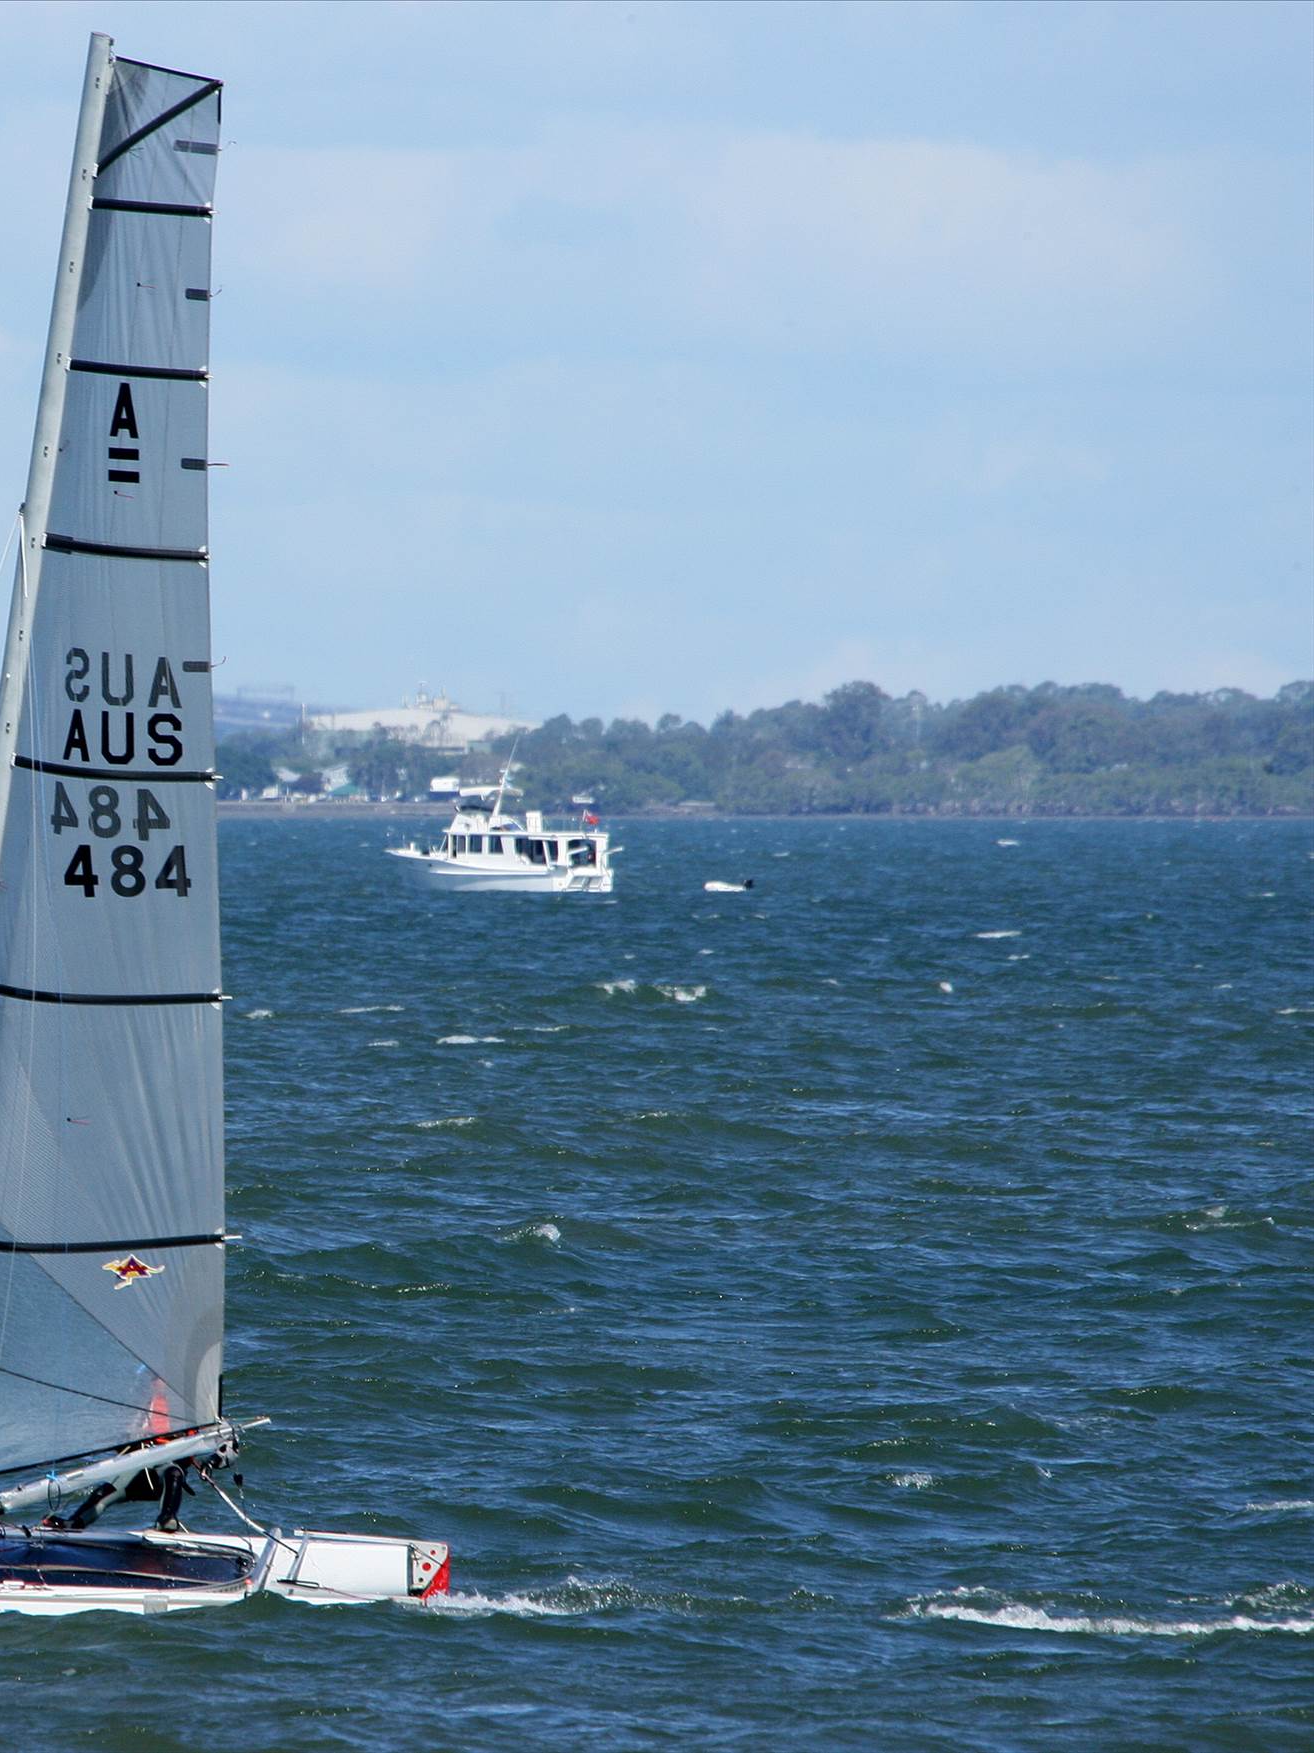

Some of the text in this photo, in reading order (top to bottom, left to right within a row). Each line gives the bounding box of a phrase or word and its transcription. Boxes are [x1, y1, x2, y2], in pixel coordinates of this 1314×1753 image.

[110, 382, 139, 439] A
[63, 709, 183, 766] AUS
[64, 844, 192, 898] 484
